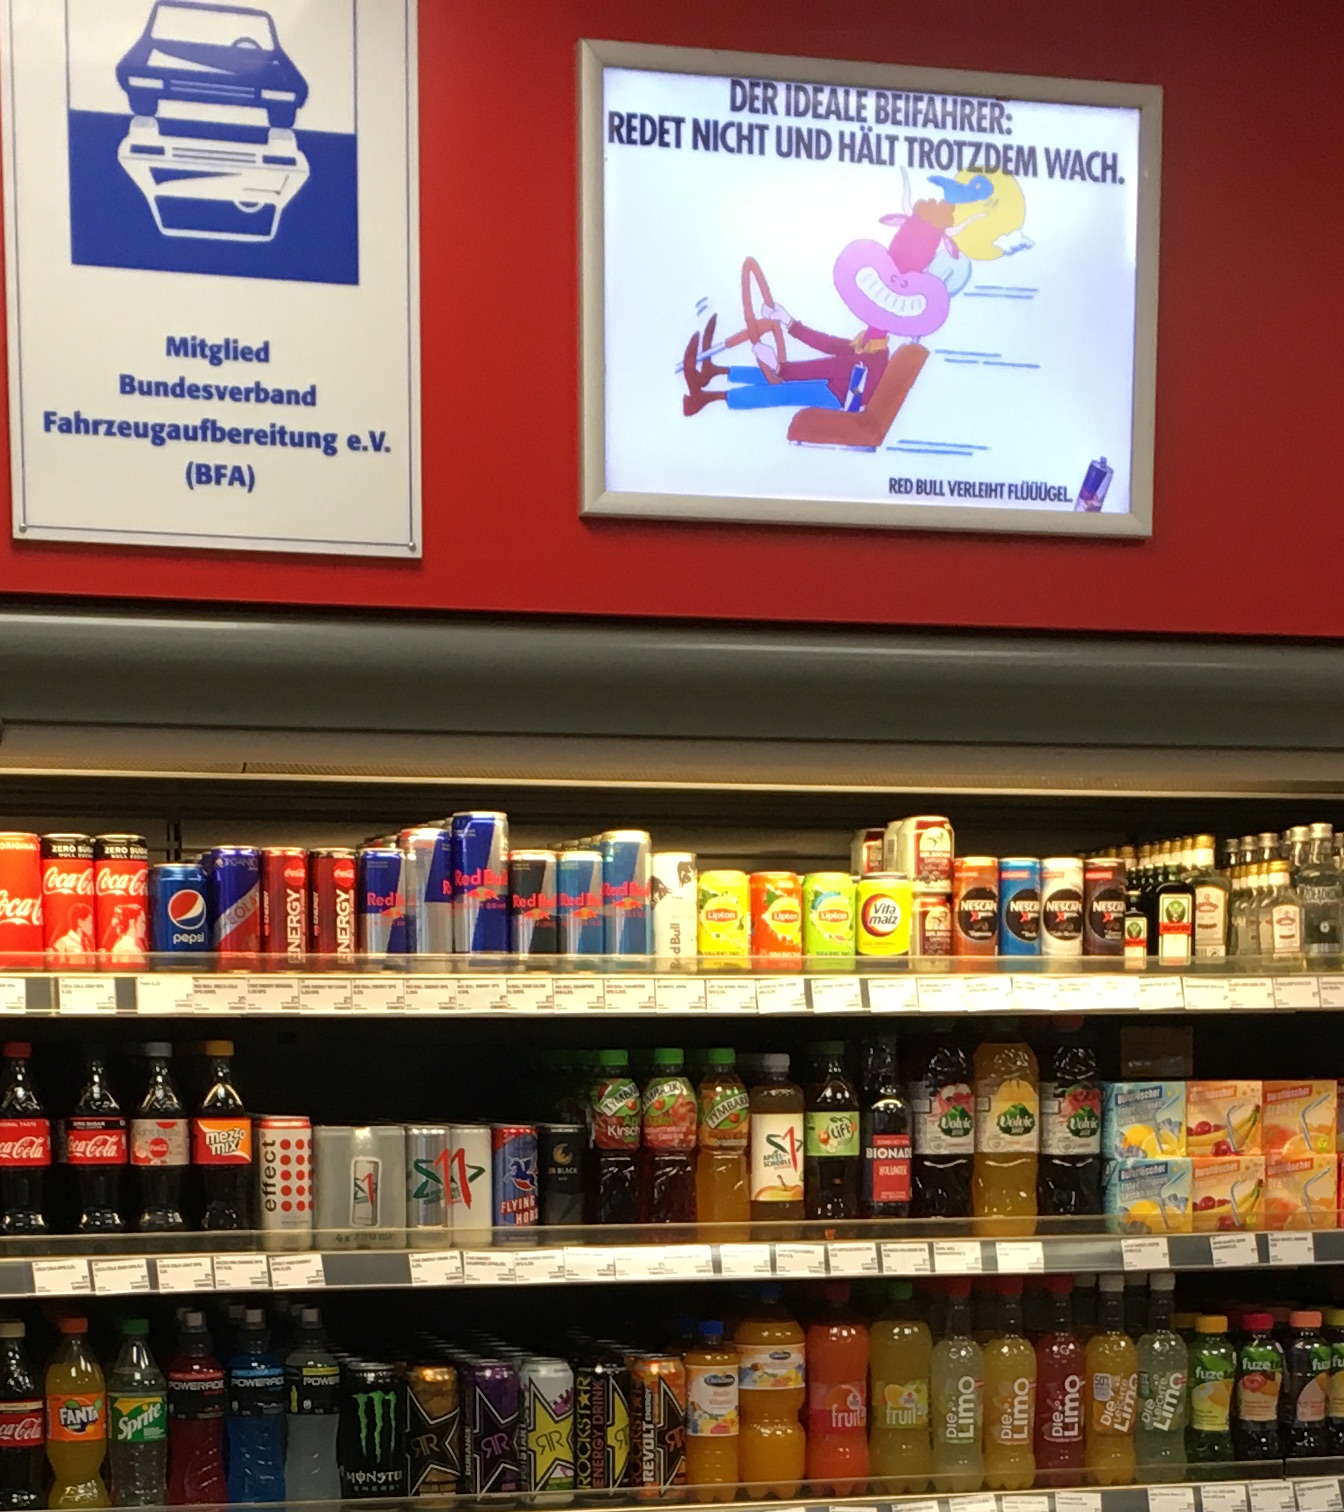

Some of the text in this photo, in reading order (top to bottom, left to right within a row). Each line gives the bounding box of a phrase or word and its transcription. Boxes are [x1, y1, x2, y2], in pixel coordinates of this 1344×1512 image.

[729, 78, 1013, 135] DER IDEALE BEIFAHRER:
[608, 111, 1126, 184] REDET NICHT UND HÄLT TROTZDEM WACH.
[164, 334, 271, 367] Mitglied
[118, 373, 317, 407] Bundesverband
[42, 410, 392, 457] Fahrzeugaufbereitung e.V.
[185, 460, 256, 494] (BFA)
[888, 476, 914, 495] RED
[915, 478, 946, 498] BULL
[947, 480, 1006, 500] VERLEIHT
[455, 869, 483, 886] Red
[707, 910, 738, 921] Lipton
[869, 914, 899, 927] malz
[873, 902, 898, 918] Vita
[172, 930, 205, 945] pepsi
[204, 1126, 247, 1146] mezzo
[210, 1139, 239, 1156] mix
[263, 1139, 277, 1213] effect
[58, 1402, 100, 1426] FANTA
[118, 1402, 163, 1441] Sprite
